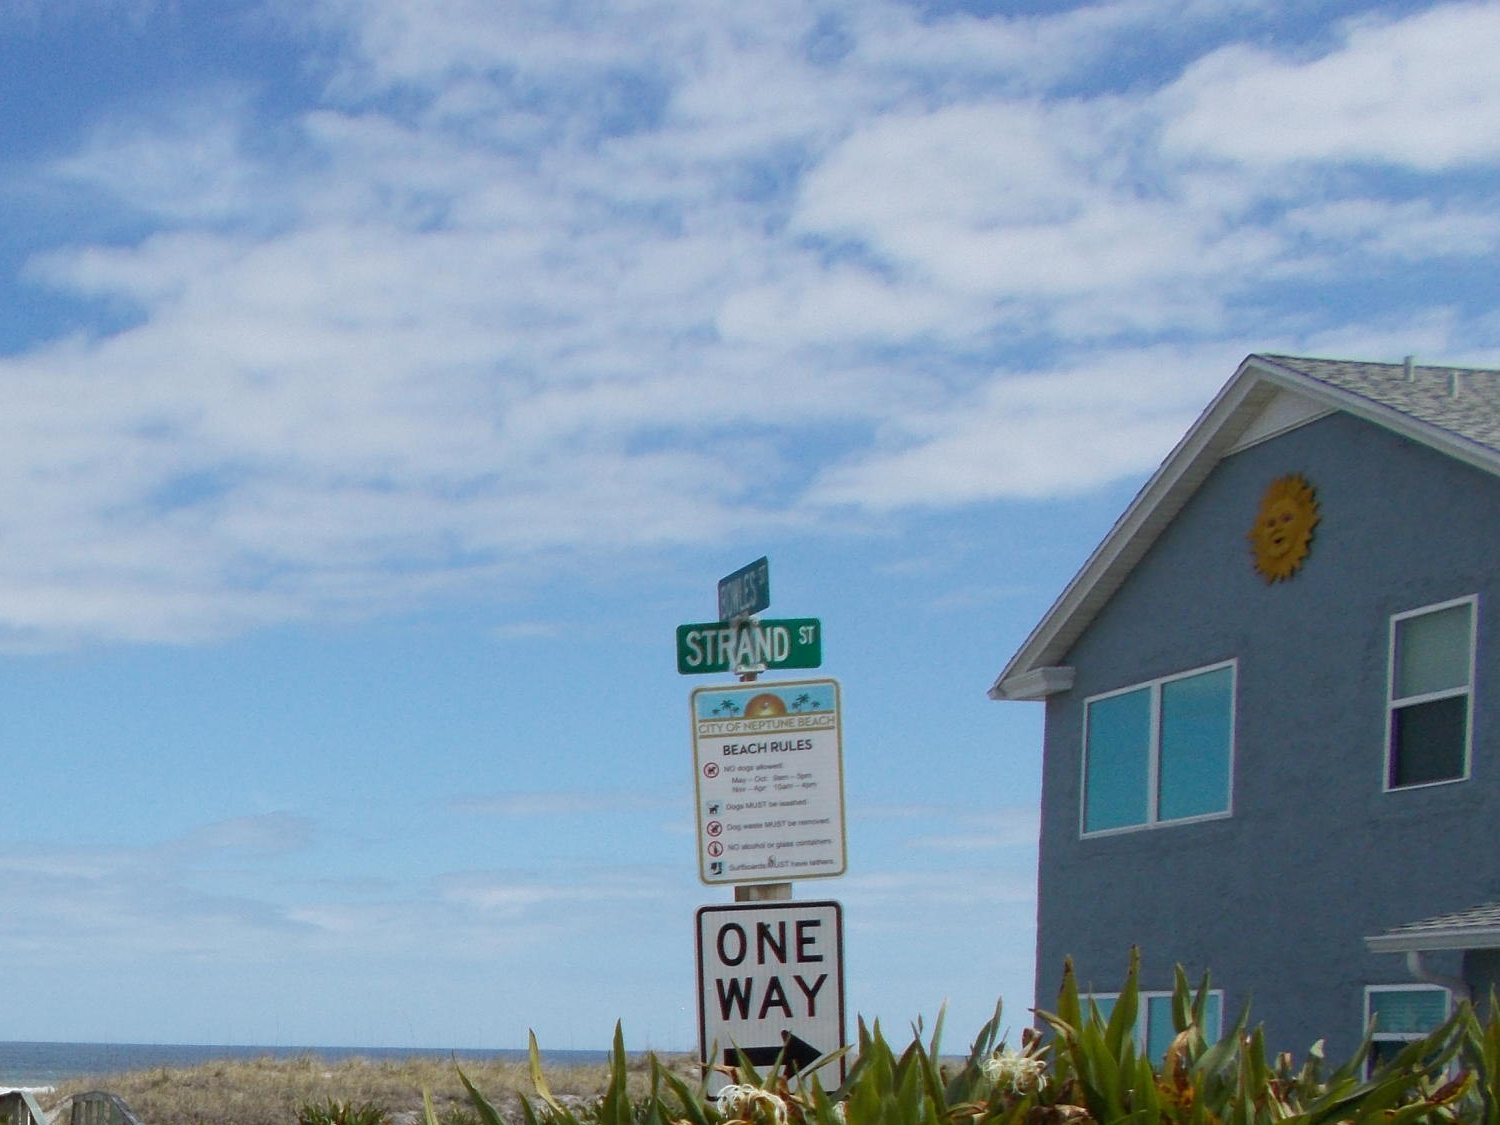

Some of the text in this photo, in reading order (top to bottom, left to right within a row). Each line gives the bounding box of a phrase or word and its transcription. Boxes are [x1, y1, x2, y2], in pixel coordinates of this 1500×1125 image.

[685, 625, 816, 666] STRAND ST
[698, 715, 835, 734] CITY OF NEPTUNE BEACH
[723, 739, 813, 756] BEACH RULES
[745, 801, 767, 809] MUST
[764, 820, 786, 828] MUST
[716, 919, 823, 967] ONE
[715, 973, 828, 1021] WAY
